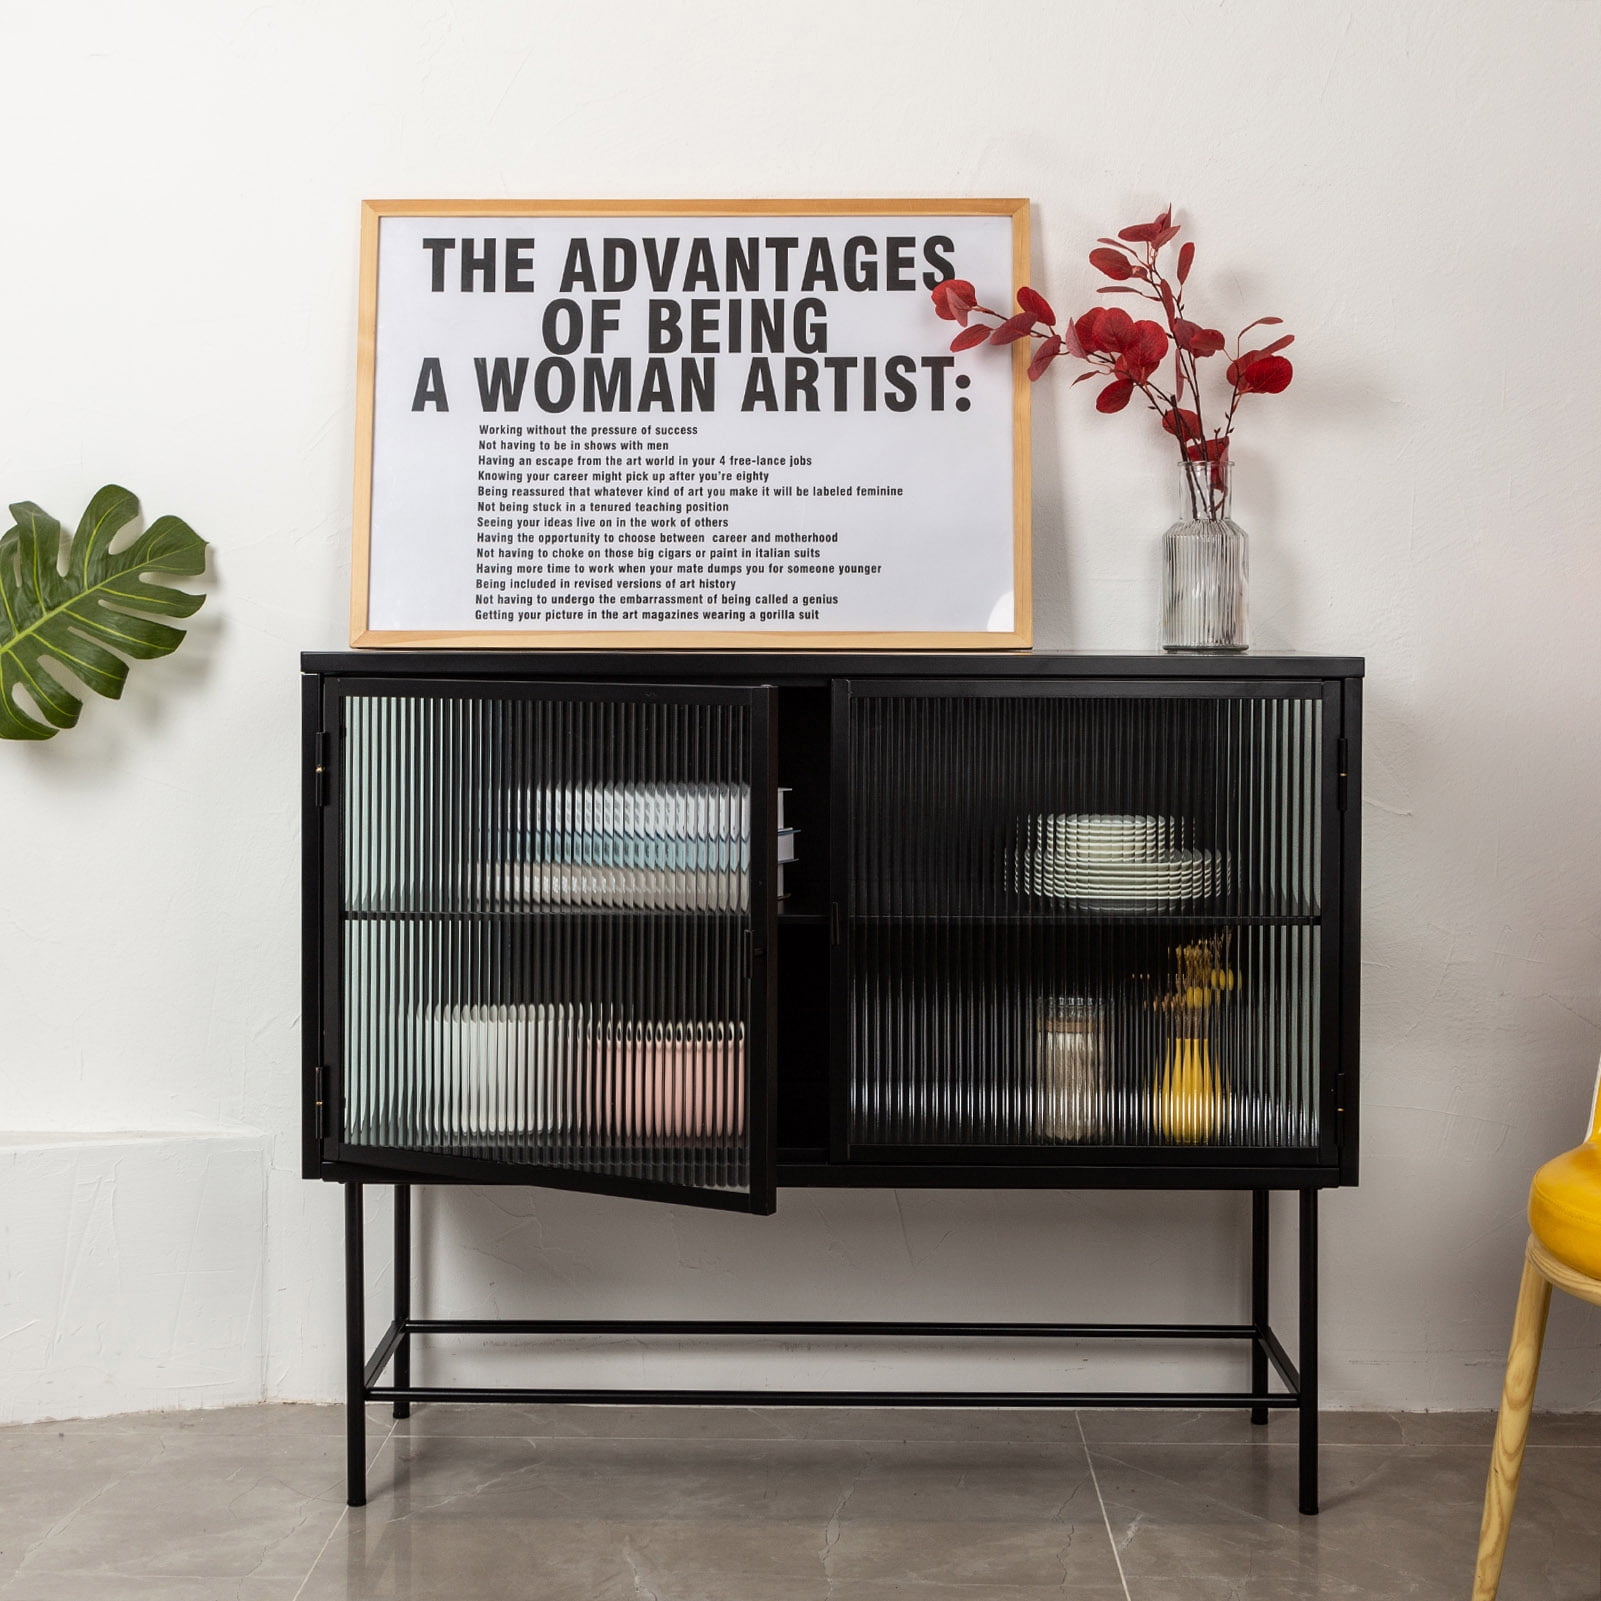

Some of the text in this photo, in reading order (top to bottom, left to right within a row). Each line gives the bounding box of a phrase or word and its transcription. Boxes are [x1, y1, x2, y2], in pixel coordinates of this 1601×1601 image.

[423, 235, 956, 293] THE ADVANTAGES
[542, 297, 828, 355] OF BEING
[411, 355, 972, 413] A WOMAN ARTIST:
[478, 425, 698, 437] Working without the pressure of success
[478, 441, 497, 449] Not
[500, 440, 536, 452] having
[539, 441, 551, 450] to
[553, 441, 567, 450] be
[570, 441, 581, 450] in
[583, 441, 617, 450] shows
[620, 440, 644, 450] with
[478, 456, 515, 467] Having
[535, 458, 574, 467] escape
[577, 456, 602, 465] from
[605, 456, 623, 465] the
[625, 456, 642, 465] art
[644, 456, 675, 465] world
[678, 456, 689, 465] in
[691, 458, 716, 467] your
[719, 456, 726, 465] 4
[729, 456, 786, 465] free-lance
[789, 456, 813, 467] jobs
[478, 471, 770, 483] Knowing your career might pick up after you're eighty
[477, 486, 904, 498] Being reassured that whatever kind of art you make it will be labeled feminine
[477, 502, 496, 511] Not
[499, 502, 529, 513] being
[532, 502, 562, 511] stuck
[565, 502, 576, 511] in
[589, 502, 632, 511] tenured
[634, 502, 682, 513] teaching
[685, 502, 729, 513] position
[476, 517, 513, 529] Seeing
[516, 520, 541, 529] your
[543, 517, 573, 527] ideas
[576, 517, 596, 527] live
[616, 517, 626, 527] in
[629, 517, 647, 527] the
[650, 517, 677, 527] work
[680, 517, 692, 527] of
[694, 517, 729, 527] others
[476, 533, 514, 544] Having
[516, 533, 535, 542] the
[538, 533, 601, 544] opportunity
[603, 533, 615, 542] to
[618, 533, 656, 542] choose
[659, 533, 705, 542] between
[750, 533, 771, 542] and
[774, 532, 839, 542] motherhood
[476, 548, 495, 557] Not
[498, 548, 534, 560] having
[537, 549, 549, 557] to
[552, 548, 585, 558] choke
[604, 548, 634, 558] those
[637, 548, 655, 559] big
[657, 548, 692, 560] cigars
[709, 548, 738, 559] paint
[741, 548, 752, 557] in
[755, 548, 791, 557] italian
[793, 548, 821, 557] suits
[476, 564, 513, 575] Having
[546, 564, 571, 573] time
[574, 564, 585, 573] to
[588, 564, 615, 573] work
[617, 564, 646, 573] when
[649, 566, 674, 575] your
[676, 564, 704, 573] mate
[707, 564, 743, 575] dumps
[745, 566, 765, 575] you
[768, 563, 784, 573] for
[787, 565, 835, 573] someone
[838, 565, 882, 575] younger
[475, 579, 737, 591] Being included in revised versions of art history
[475, 594, 839, 606] Not having to undergo the embarrassment of being called a genius
[474, 610, 514, 621] Getting
[517, 612, 542, 621] your
[545, 609, 584, 621] picture
[587, 610, 598, 619] in
[601, 609, 619, 619] the
[622, 610, 638, 619] art
[641, 610, 699, 621] magazines
[702, 610, 746, 622] wearing
[759, 610, 796, 621] gorilla
[798, 610, 820, 619] suit
